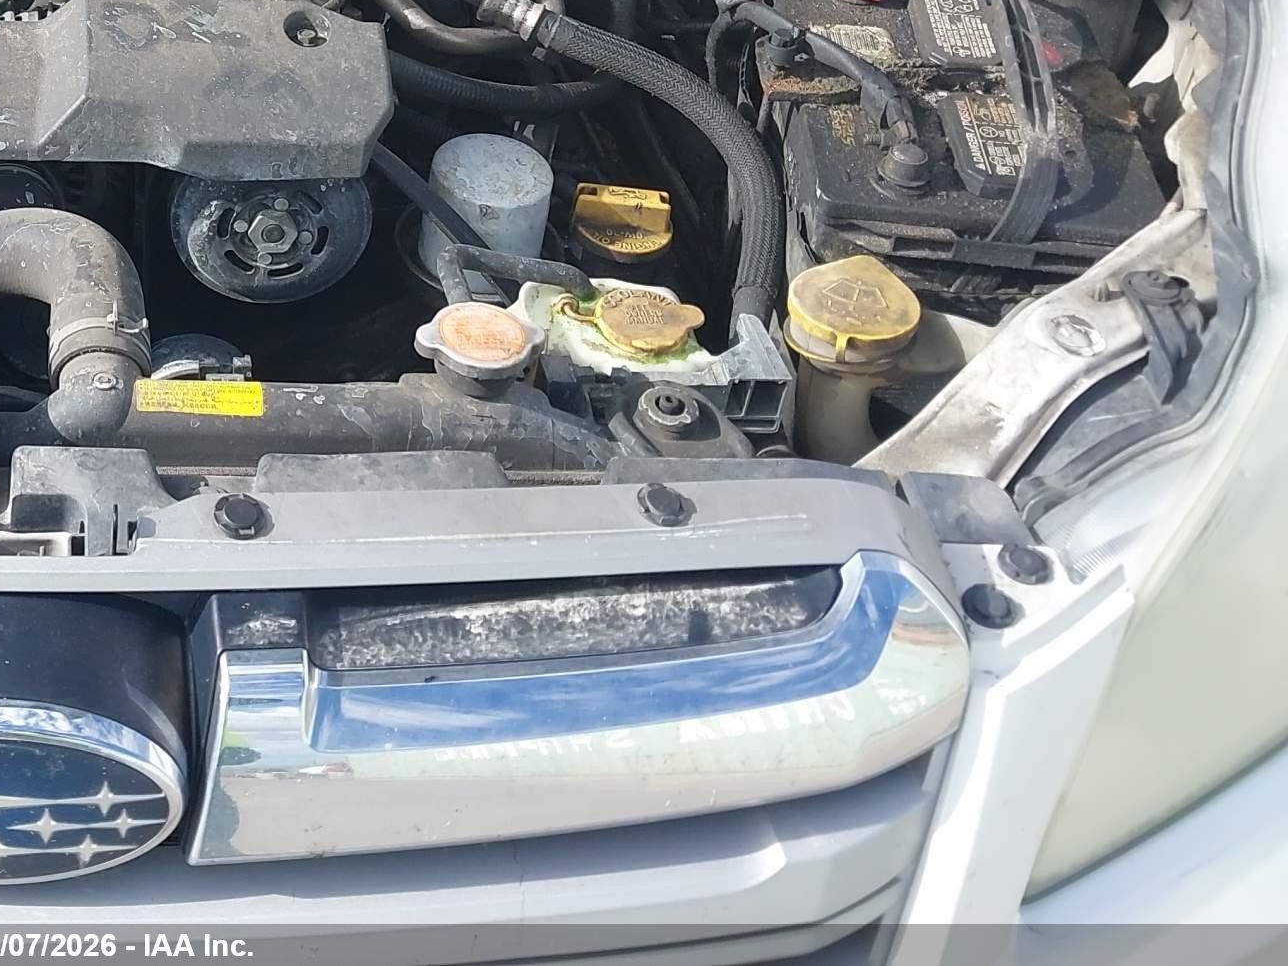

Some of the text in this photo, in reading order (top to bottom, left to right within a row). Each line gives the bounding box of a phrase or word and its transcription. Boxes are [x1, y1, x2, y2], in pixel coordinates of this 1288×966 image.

[953, 99, 973, 126] POISON
[965, 132, 985, 163] DANGER
[614, 238, 662, 251] ENGINE
